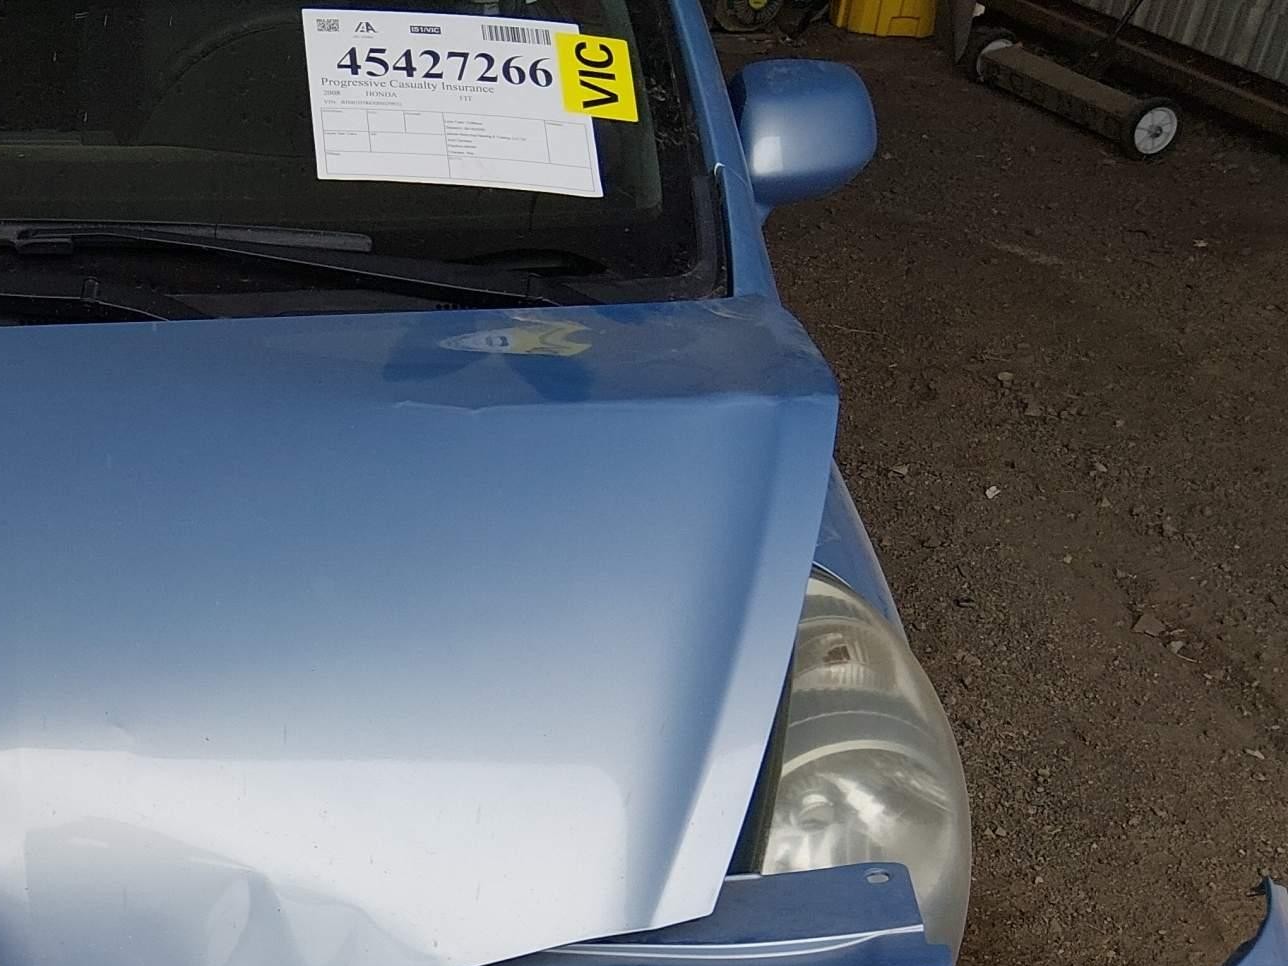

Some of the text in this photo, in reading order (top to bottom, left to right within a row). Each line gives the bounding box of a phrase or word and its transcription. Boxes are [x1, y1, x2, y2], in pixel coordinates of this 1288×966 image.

[322, 77, 494, 94] Progressive Casualty Insurance
[337, 47, 552, 87] 45427266
[574, 41, 619, 110] VIC
